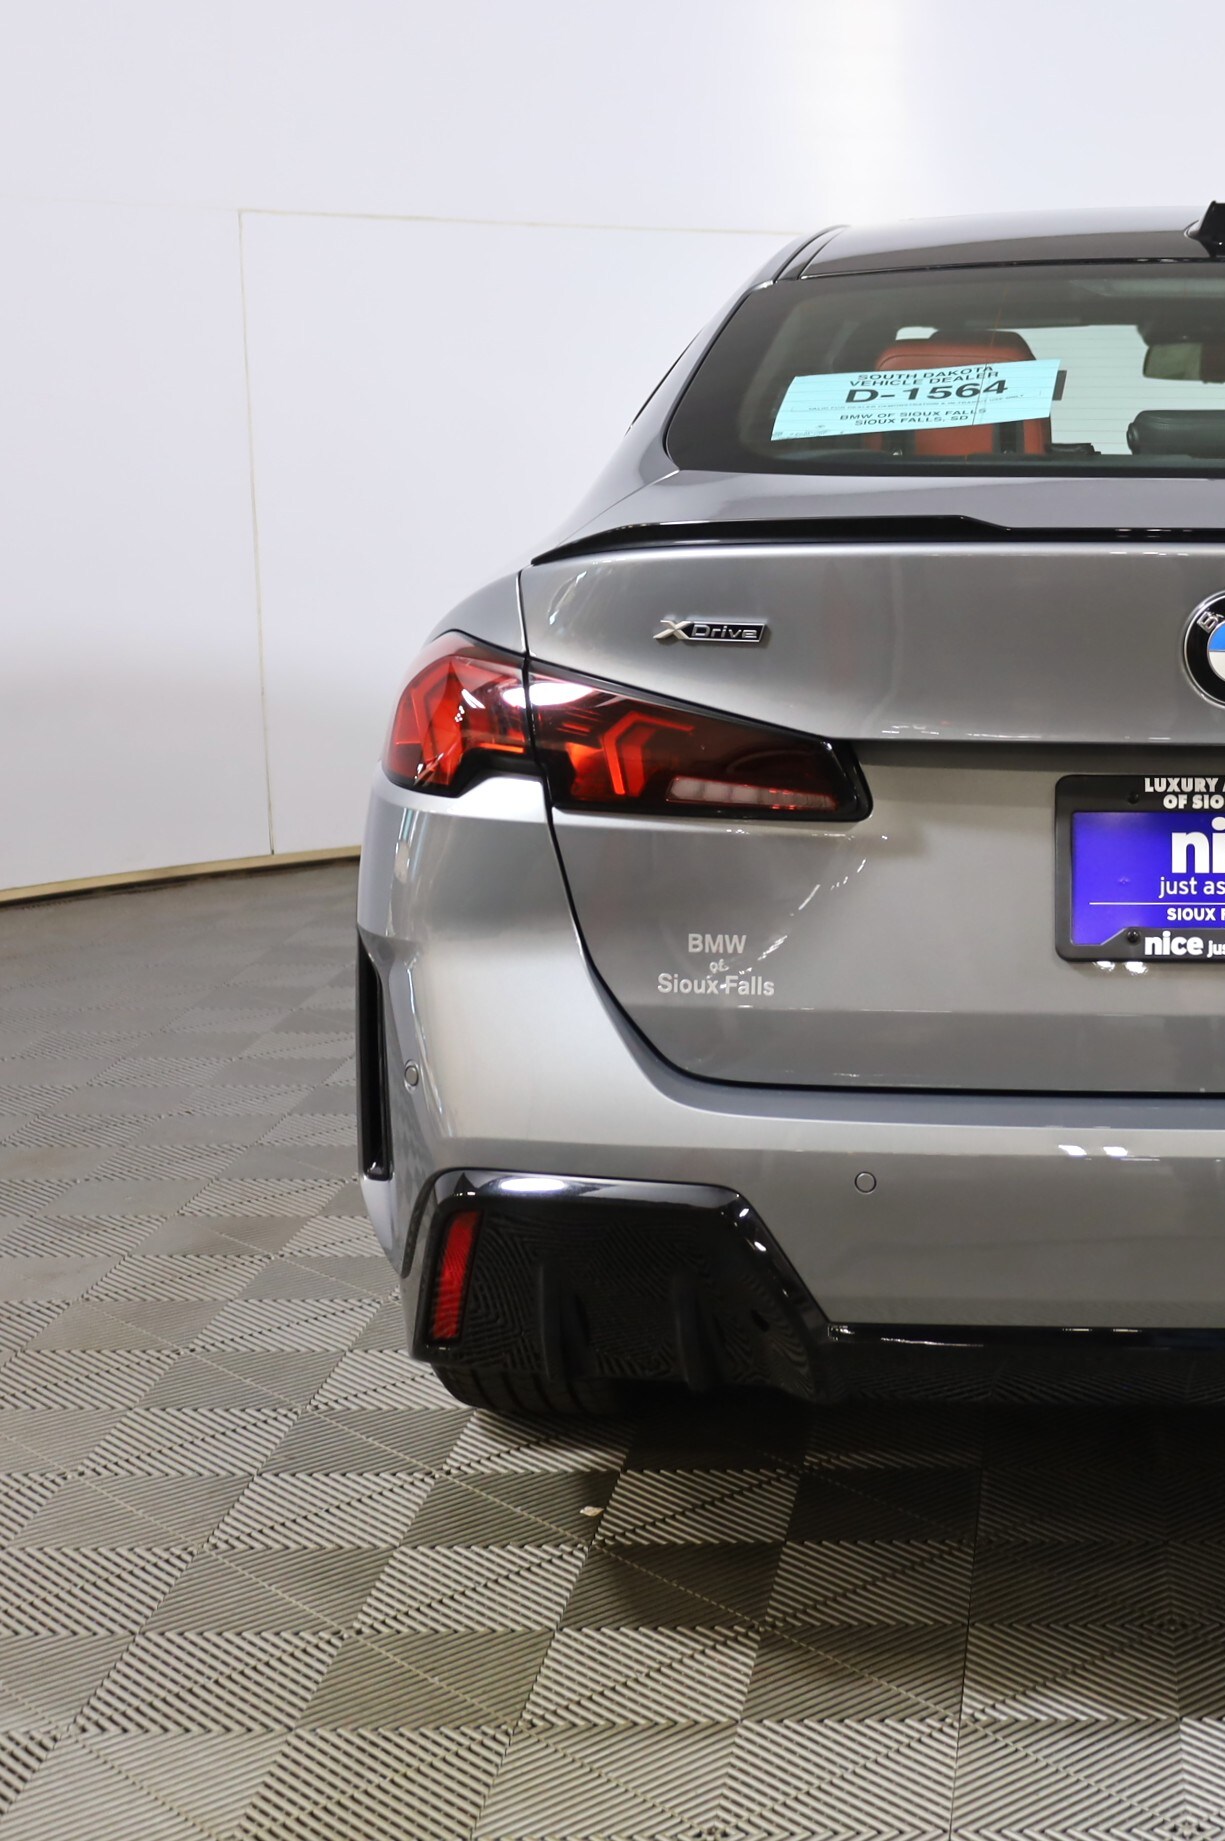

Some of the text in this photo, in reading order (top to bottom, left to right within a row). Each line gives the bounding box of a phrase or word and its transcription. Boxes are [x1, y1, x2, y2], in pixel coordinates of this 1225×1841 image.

[850, 371, 999, 387] VEHICLE DEALER
[858, 366, 993, 381] SOUTH DAKOTA
[845, 379, 1008, 403] D-1564
[855, 418, 896, 426] SIOUX
[1144, 777, 1219, 793] LUXURY
[1163, 794, 1188, 810] OF
[1158, 876, 1198, 899] just
[1166, 908, 1216, 922] SIOUX
[687, 933, 747, 954] BMW
[1144, 930, 1204, 956] nice
[657, 973, 775, 996] Sioux Falls
